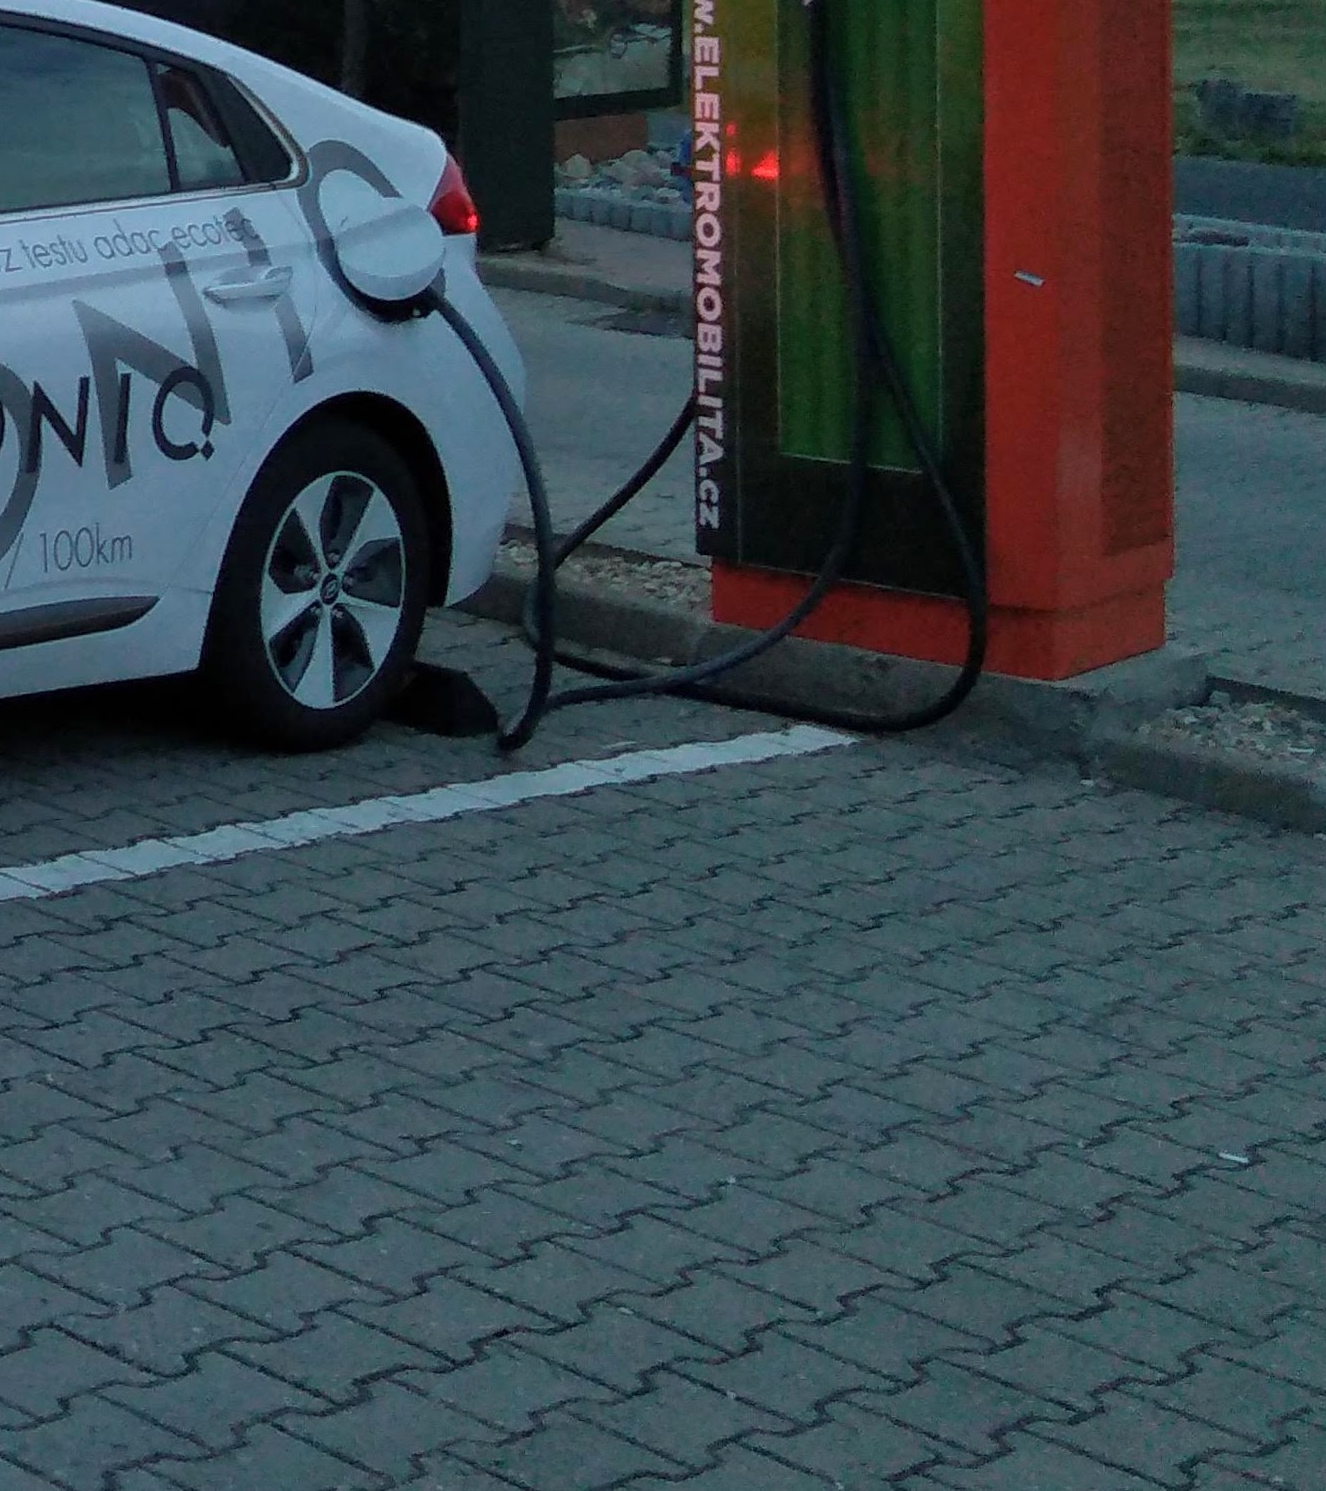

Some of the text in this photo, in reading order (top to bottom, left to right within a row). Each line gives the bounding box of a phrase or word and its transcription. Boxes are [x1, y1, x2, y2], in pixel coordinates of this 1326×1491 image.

[19, 234, 89, 268] testu
[93, 218, 160, 260] adac
[38, 522, 133, 573] 100km
